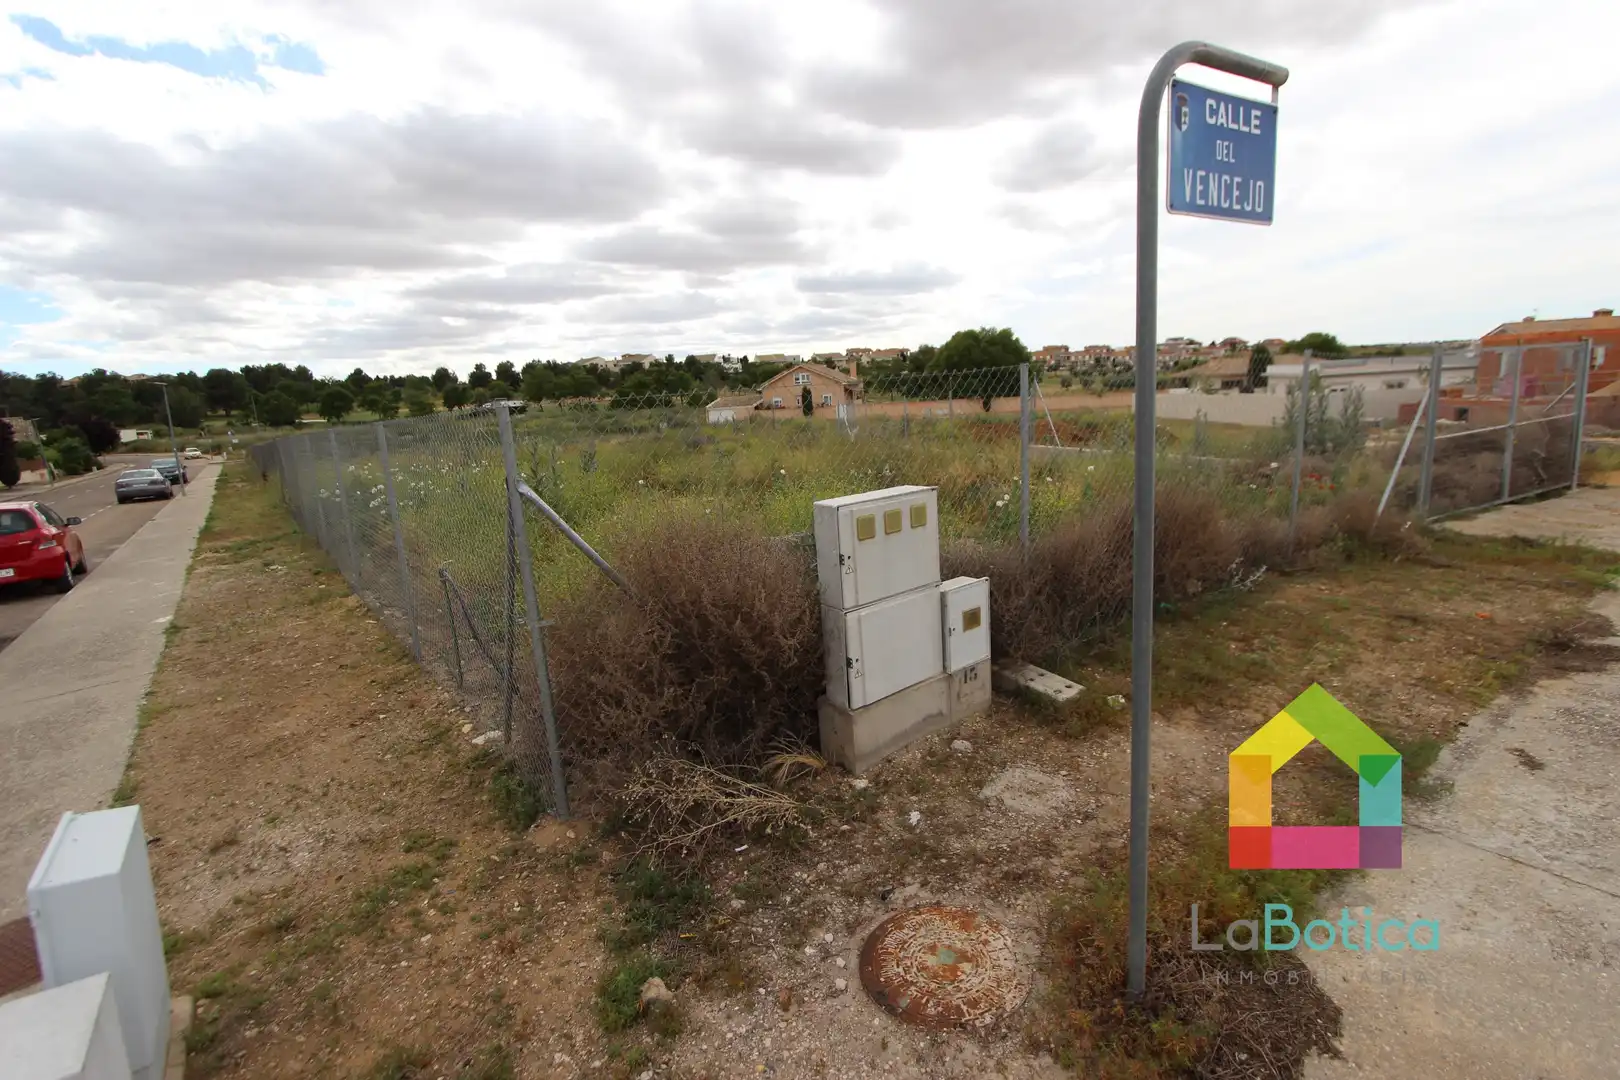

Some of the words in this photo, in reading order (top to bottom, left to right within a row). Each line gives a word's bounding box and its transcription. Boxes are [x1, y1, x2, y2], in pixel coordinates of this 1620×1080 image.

[1205, 98, 1262, 135] CALLE
[1216, 140, 1235, 163] DEL
[1184, 168, 1264, 213] VENCEJO
